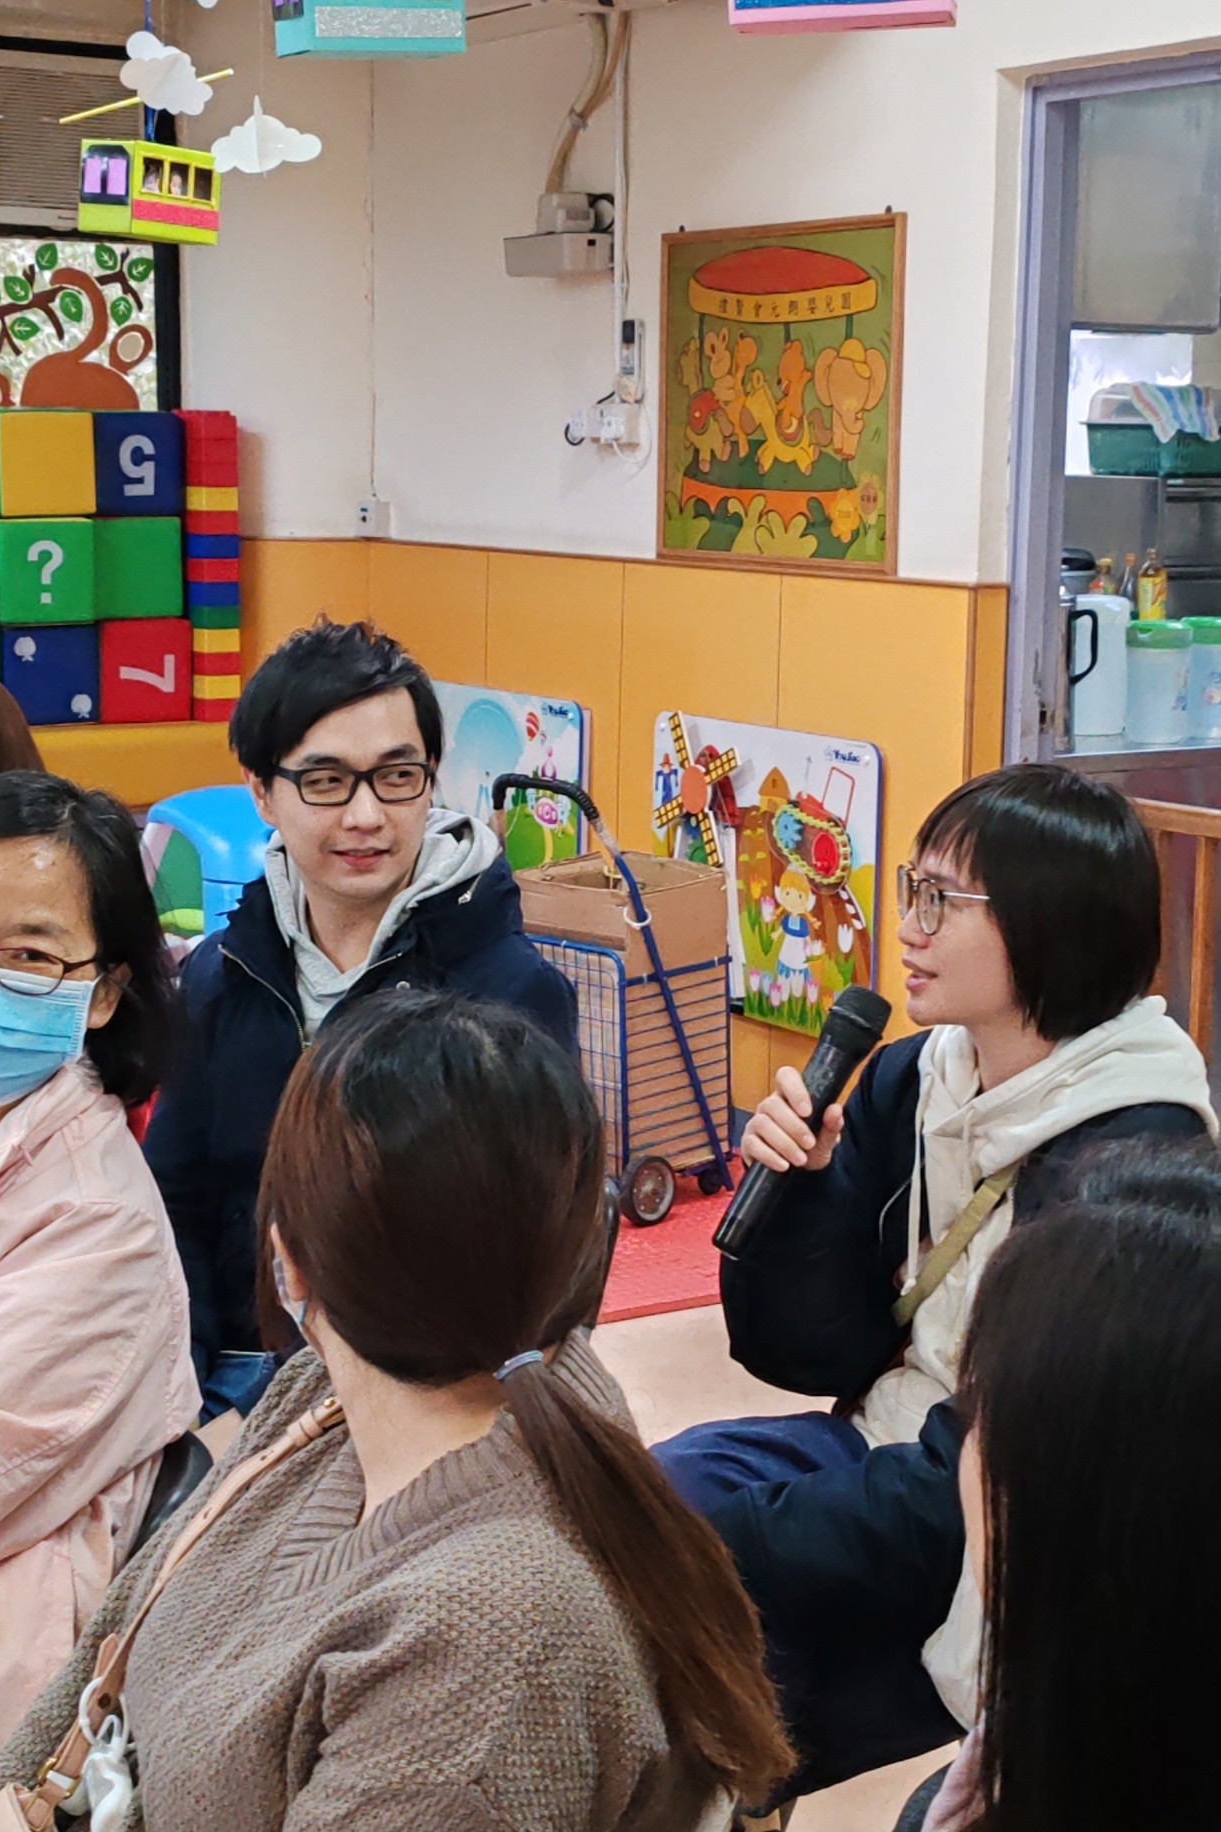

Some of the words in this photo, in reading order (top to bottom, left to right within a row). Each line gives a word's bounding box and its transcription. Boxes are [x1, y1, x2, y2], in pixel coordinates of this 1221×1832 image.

[118, 434, 156, 497] 5
[26, 539, 64, 604] ?
[118, 653, 176, 694] 7
